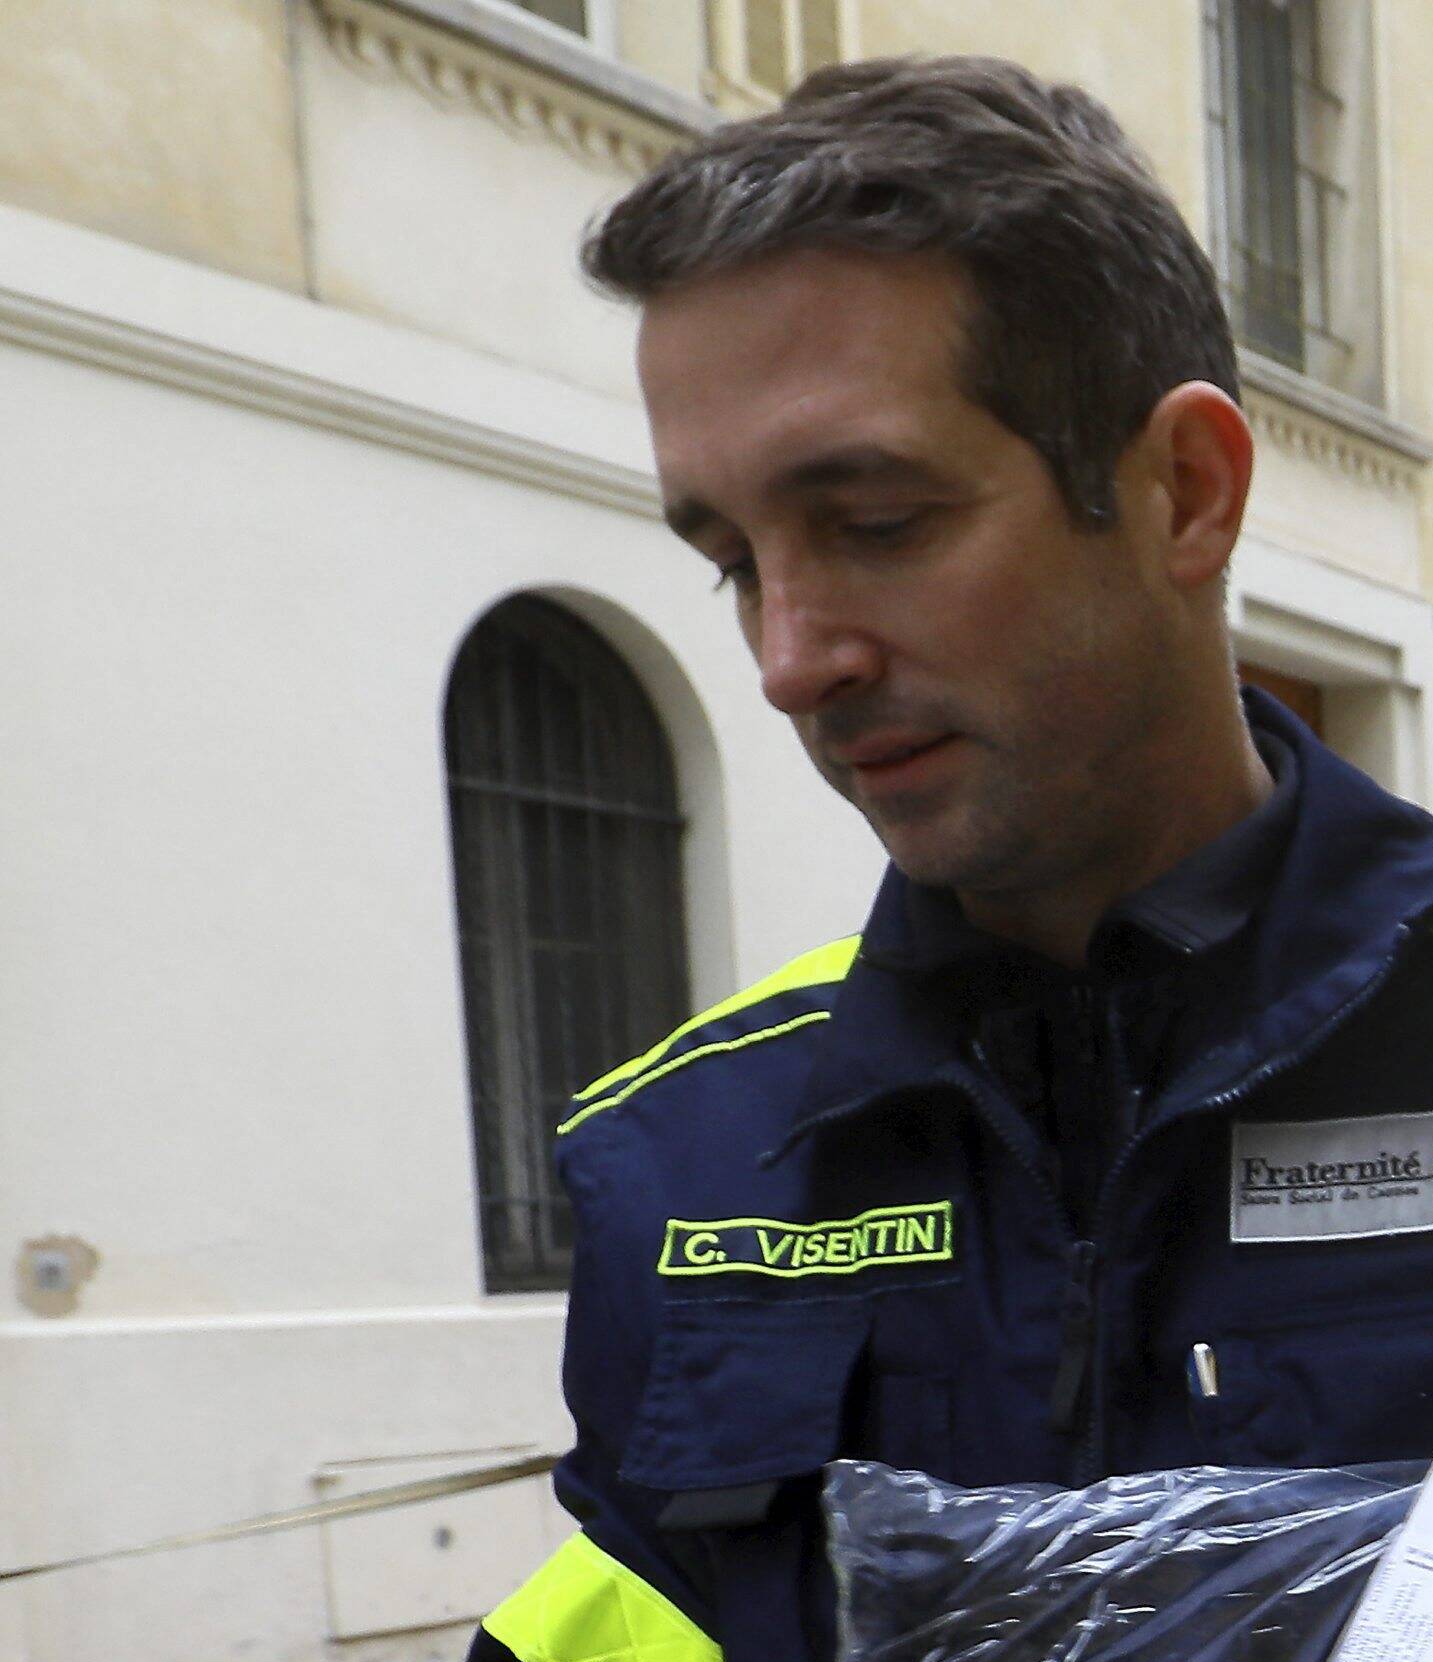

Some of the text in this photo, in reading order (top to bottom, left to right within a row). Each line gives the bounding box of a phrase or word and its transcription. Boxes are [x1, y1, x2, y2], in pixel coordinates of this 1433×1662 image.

[1239, 1151, 1422, 1187] Fraternité
[683, 1214, 937, 1268] C. VISENTIN
